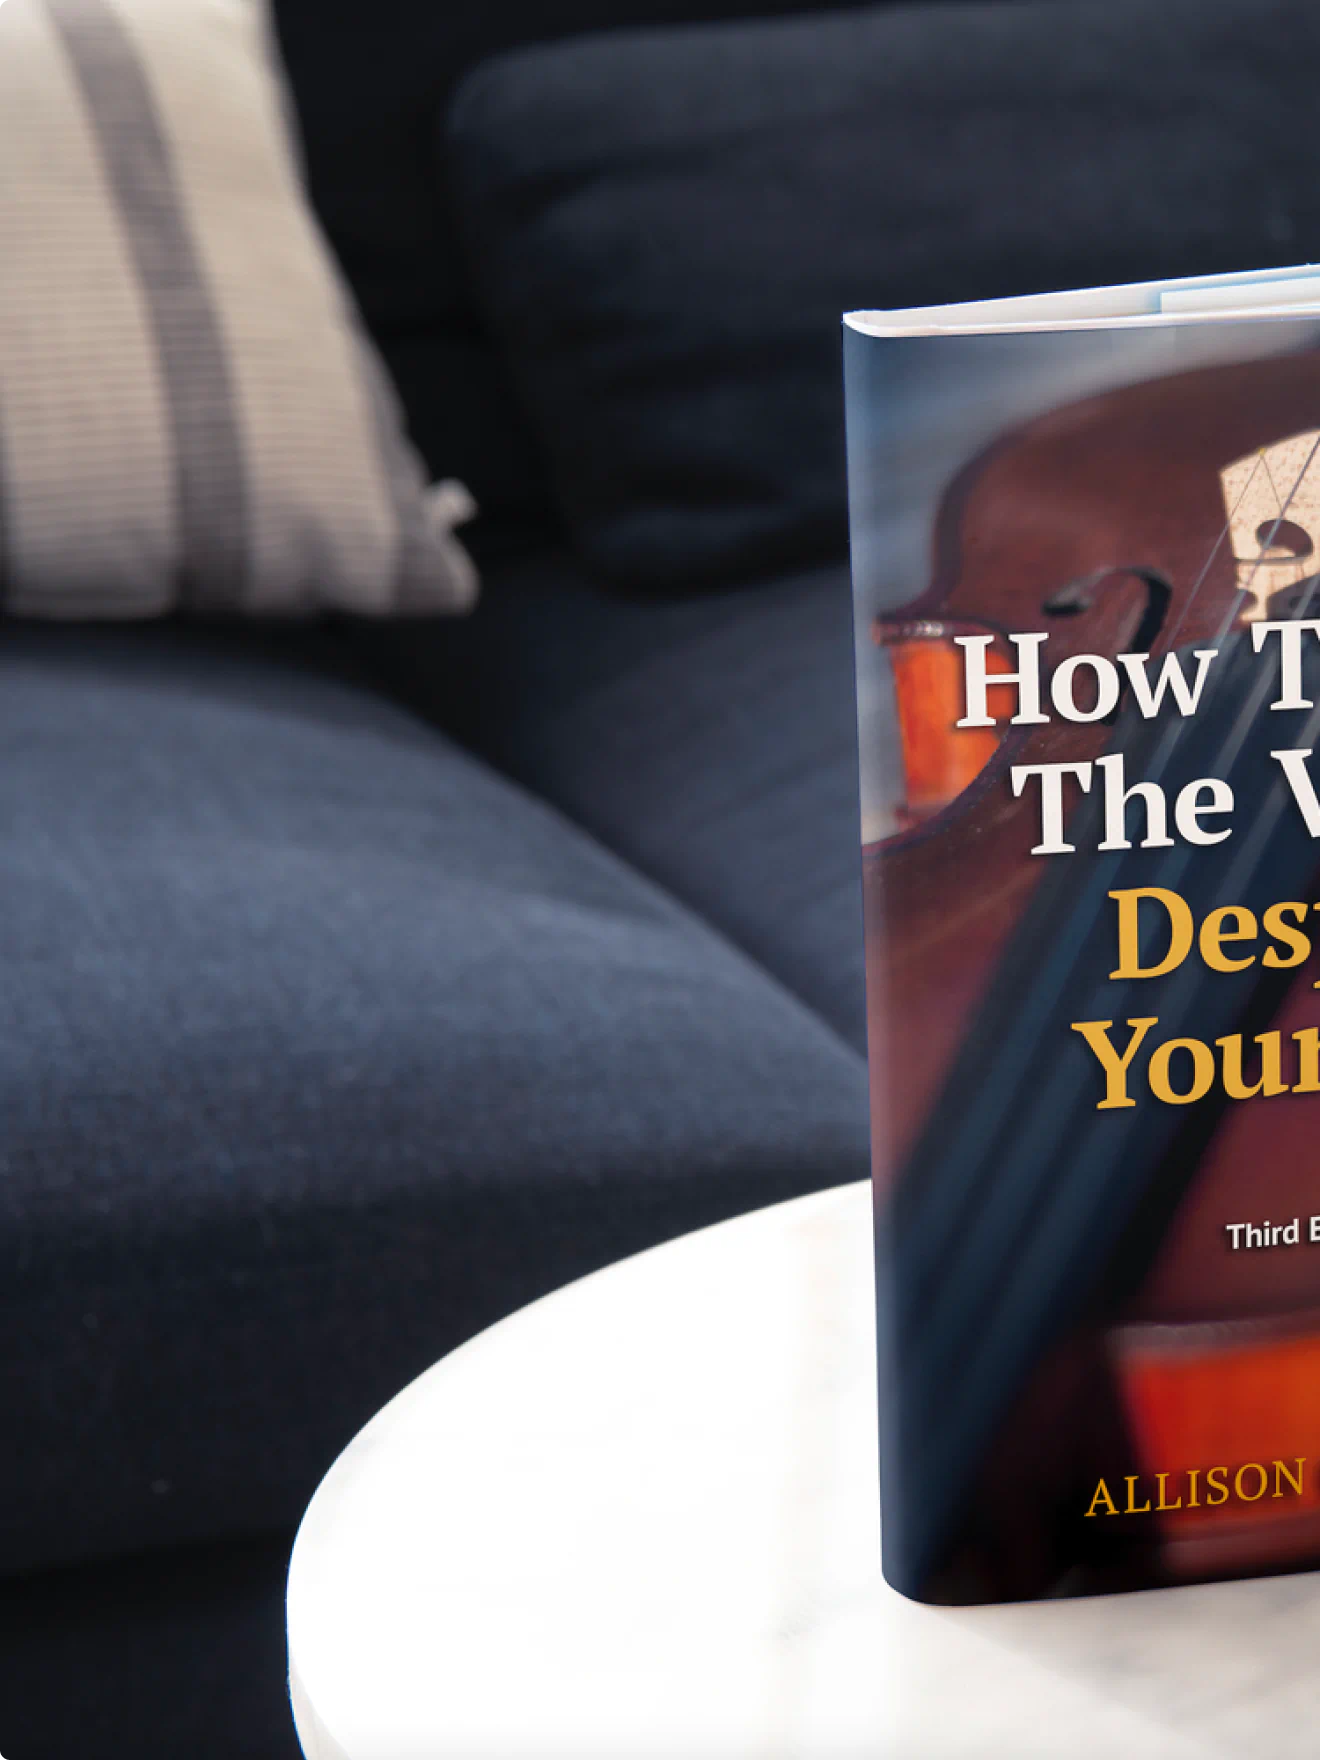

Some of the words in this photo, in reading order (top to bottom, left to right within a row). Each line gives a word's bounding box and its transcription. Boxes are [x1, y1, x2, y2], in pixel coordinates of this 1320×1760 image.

[954, 632, 1217, 728] How
[1012, 755, 1233, 854] The
[1226, 1218, 1299, 1249] Third
[1084, 1458, 1306, 1516] ALLISON
